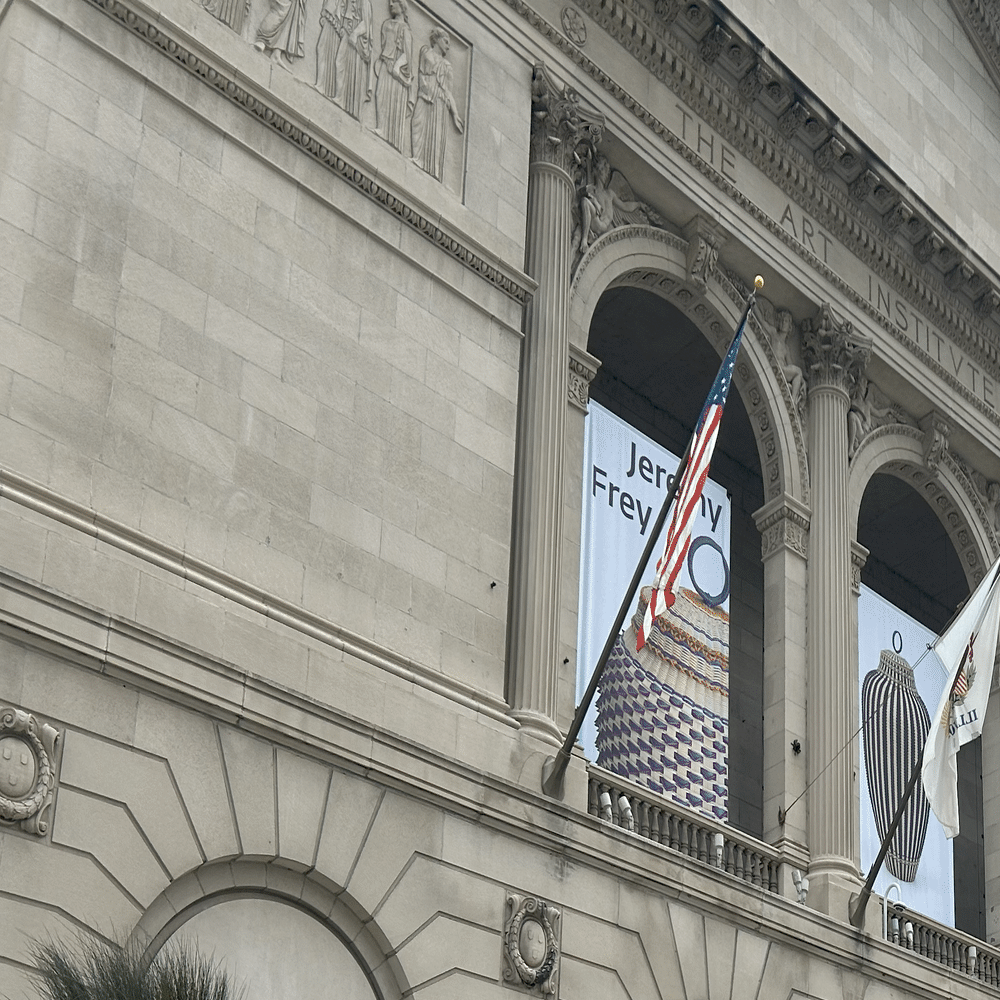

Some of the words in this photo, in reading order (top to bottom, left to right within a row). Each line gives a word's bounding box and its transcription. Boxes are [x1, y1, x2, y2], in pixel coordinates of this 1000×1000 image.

[675, 103, 737, 184] THE
[779, 203, 834, 264] ART
[868, 274, 995, 409] INSTITVTE
[592, 464, 653, 536] Frey
